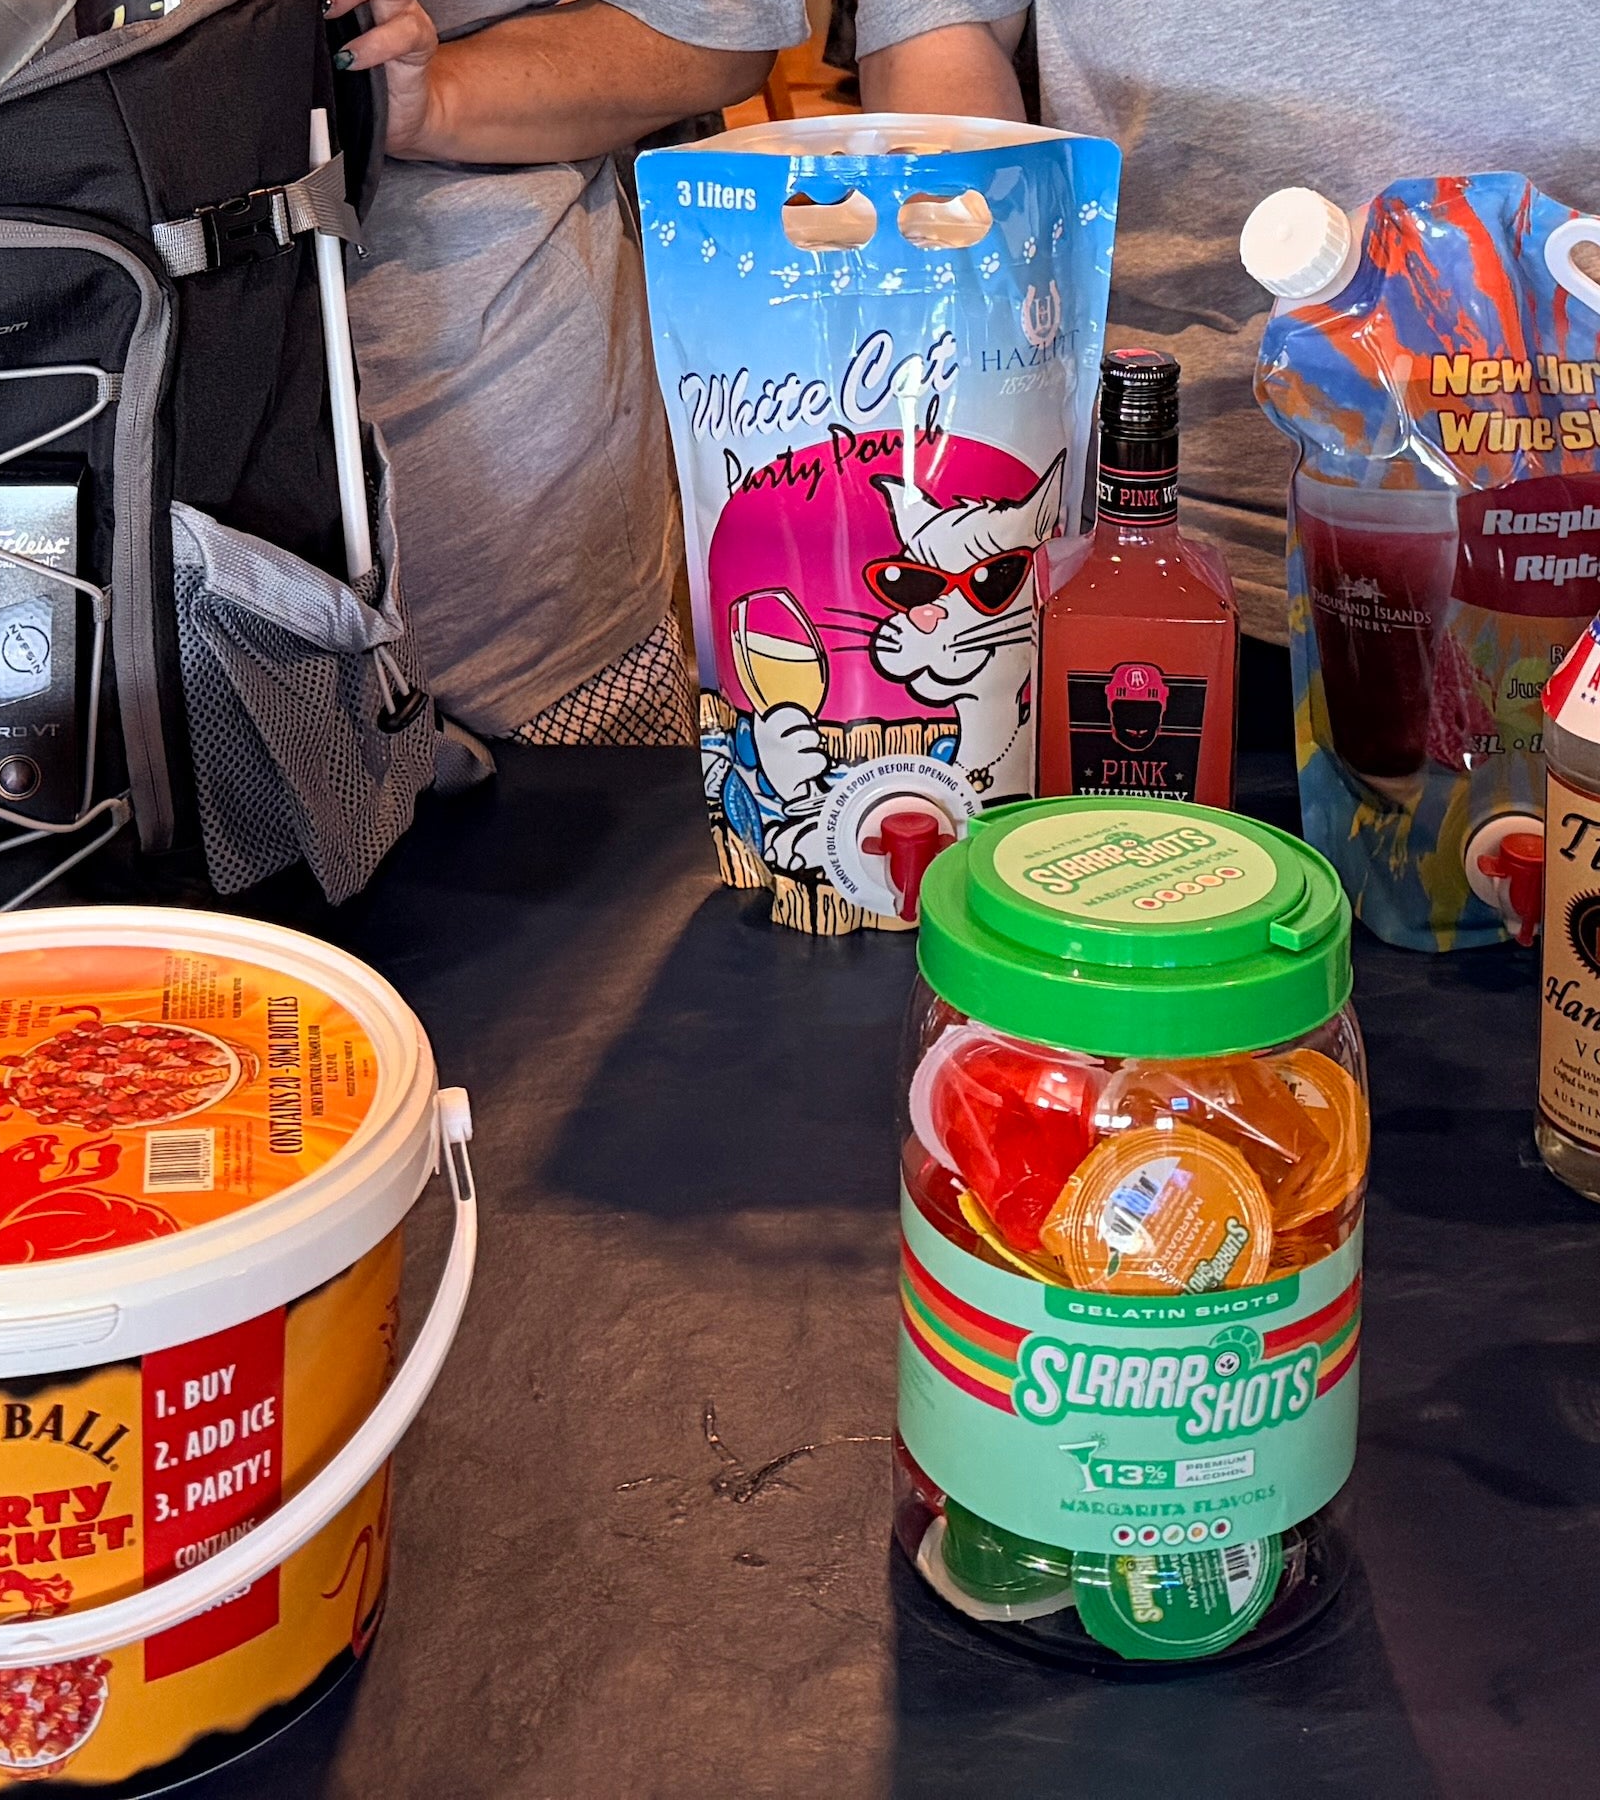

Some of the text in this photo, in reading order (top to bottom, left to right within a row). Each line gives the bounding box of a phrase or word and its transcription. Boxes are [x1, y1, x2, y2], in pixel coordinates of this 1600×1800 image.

[677, 180, 757, 211] 3 Liters
[1430, 352, 1533, 396] New
[679, 366, 832, 443] White
[723, 393, 944, 502] Party Pouh
[1438, 408, 1557, 455] Wine
[1119, 487, 1161, 508] PINK
[1374, 604, 1433, 624] ISLANDS
[1101, 759, 1169, 788] PINK
[826, 762, 960, 895] REMOVE FOIL SEAL ON SPOUT BEFORE OPENING
[1027, 826, 1213, 895] SLRRRP SHOTS
[267, 995, 300, 1042] BOTTLES
[268, 1076, 302, 1092] 20
[268, 1091, 303, 1155] CONTAINS
[1159, 1195, 1204, 1266] MARGAR
[1166, 1217, 1204, 1273] MANGO
[1068, 1291, 1280, 1321] GELATIN SHOTS
[155, 1363, 236, 1419] 1. BUY
[1023, 1343, 1315, 1437] SLRRRP SHOTS
[154, 1396, 276, 1471] 2. ADD ICE
[155, 1449, 272, 1522] 3. PARTY!
[1184, 1454, 1247, 1471] PREMIUM
[1184, 1467, 1247, 1483] ALCOHOL
[1059, 1484, 1277, 1518] MARGARITA FLAVORS
